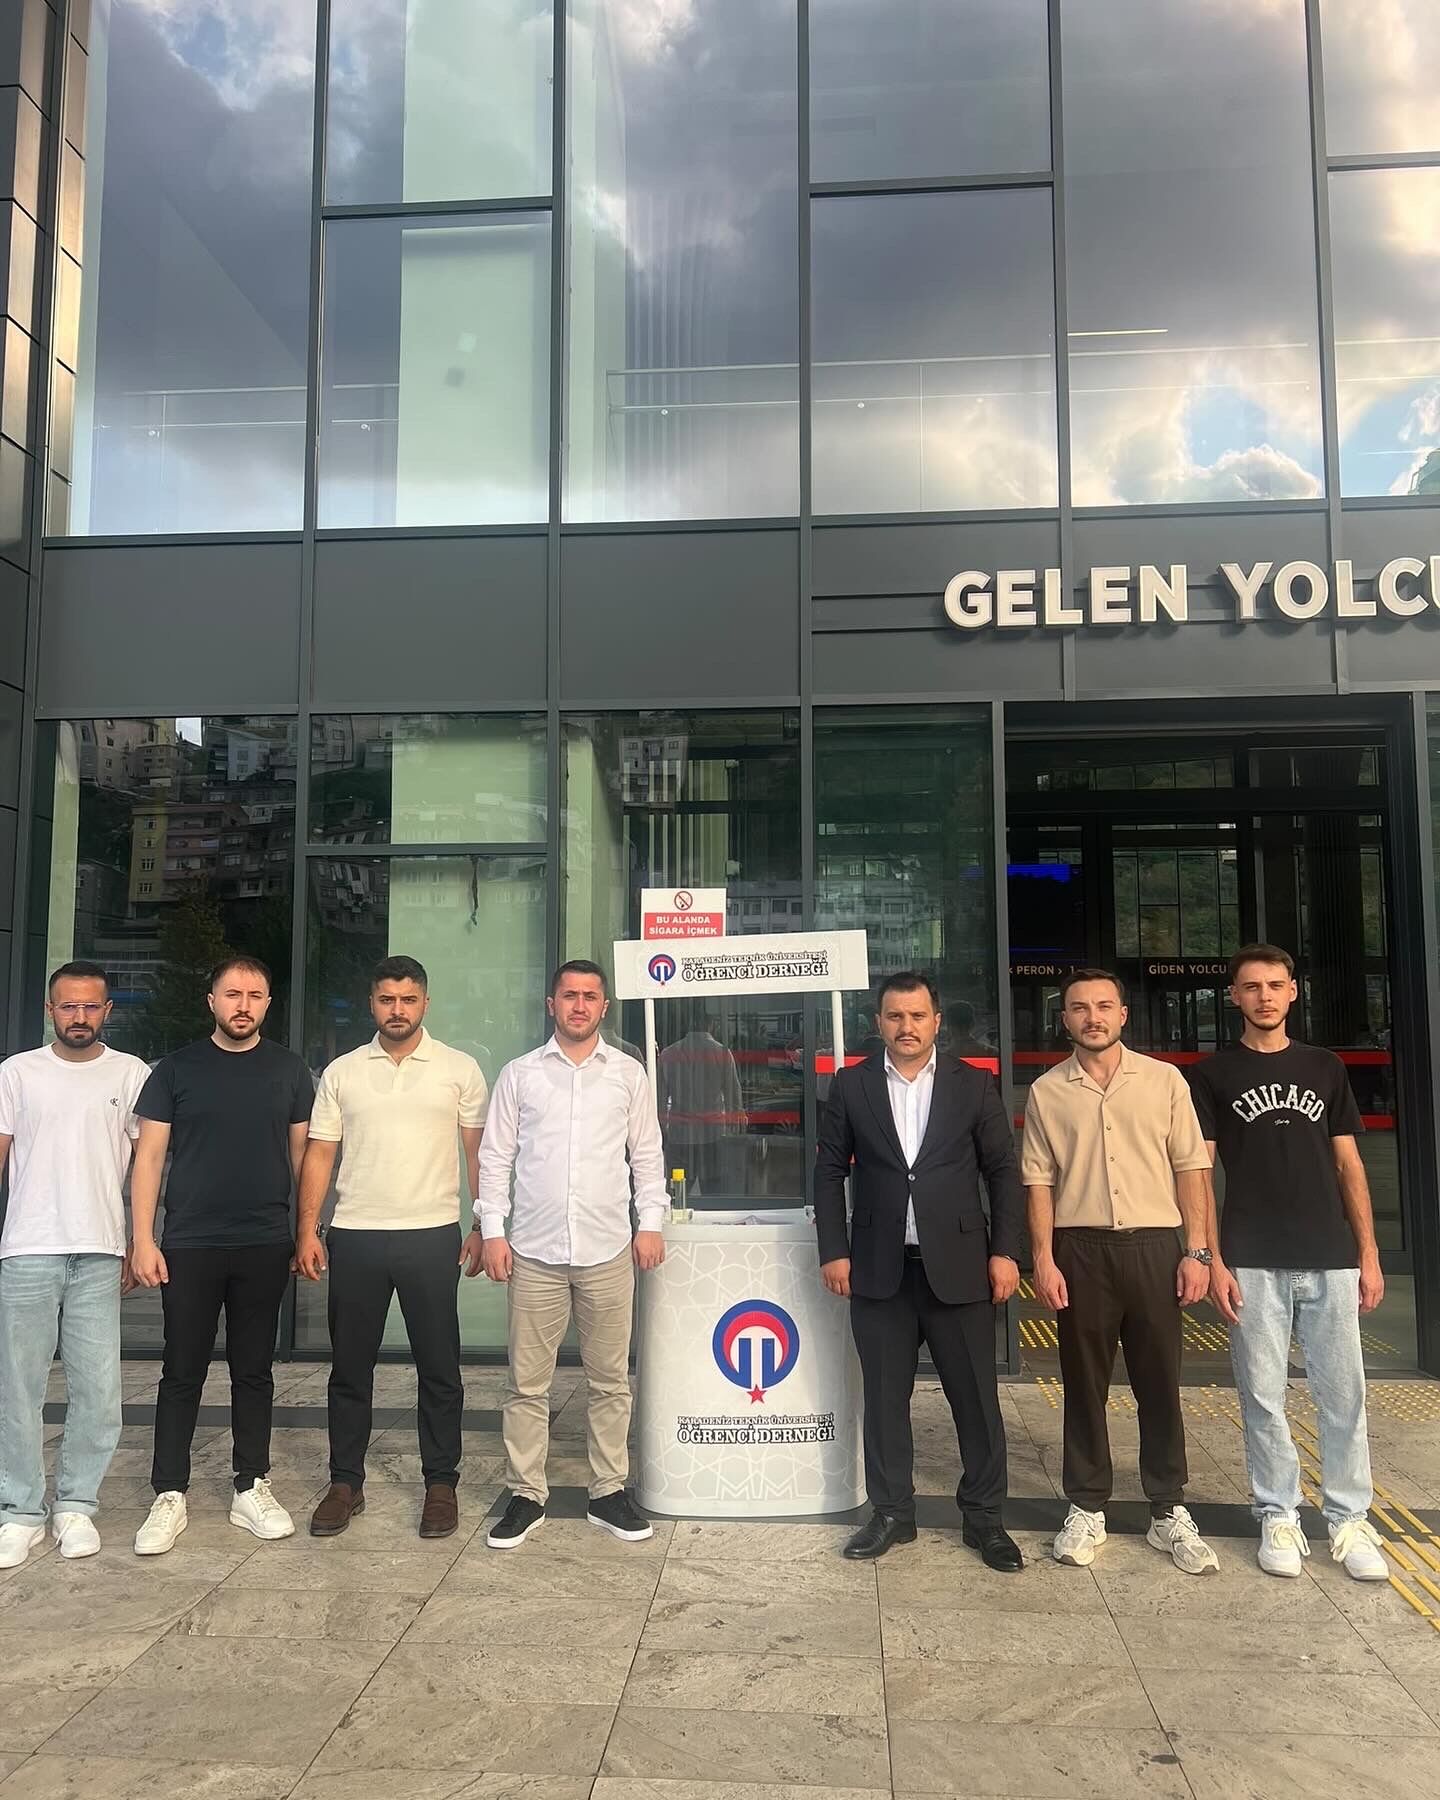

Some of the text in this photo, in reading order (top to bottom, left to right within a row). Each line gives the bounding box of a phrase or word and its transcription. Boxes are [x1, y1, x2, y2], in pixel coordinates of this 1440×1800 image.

[944, 556, 1440, 629] GELEN YOLC
[656, 916, 710, 924] BU ALANDA
[649, 925, 717, 936] SİGARA İÇMEK
[682, 958, 828, 982] ÖĞRENCİ DERNEĞİ
[1016, 965, 1055, 975] PERON
[1148, 964, 1227, 975] GİDEN YOLCU
[1231, 1083, 1325, 1122] CHICAGO
[678, 1415, 732, 1425] KARADENİZ
[732, 1415, 769, 1425] TEKNİK
[678, 1422, 835, 1444] ÖĞRENCİ DERNEĞİ
